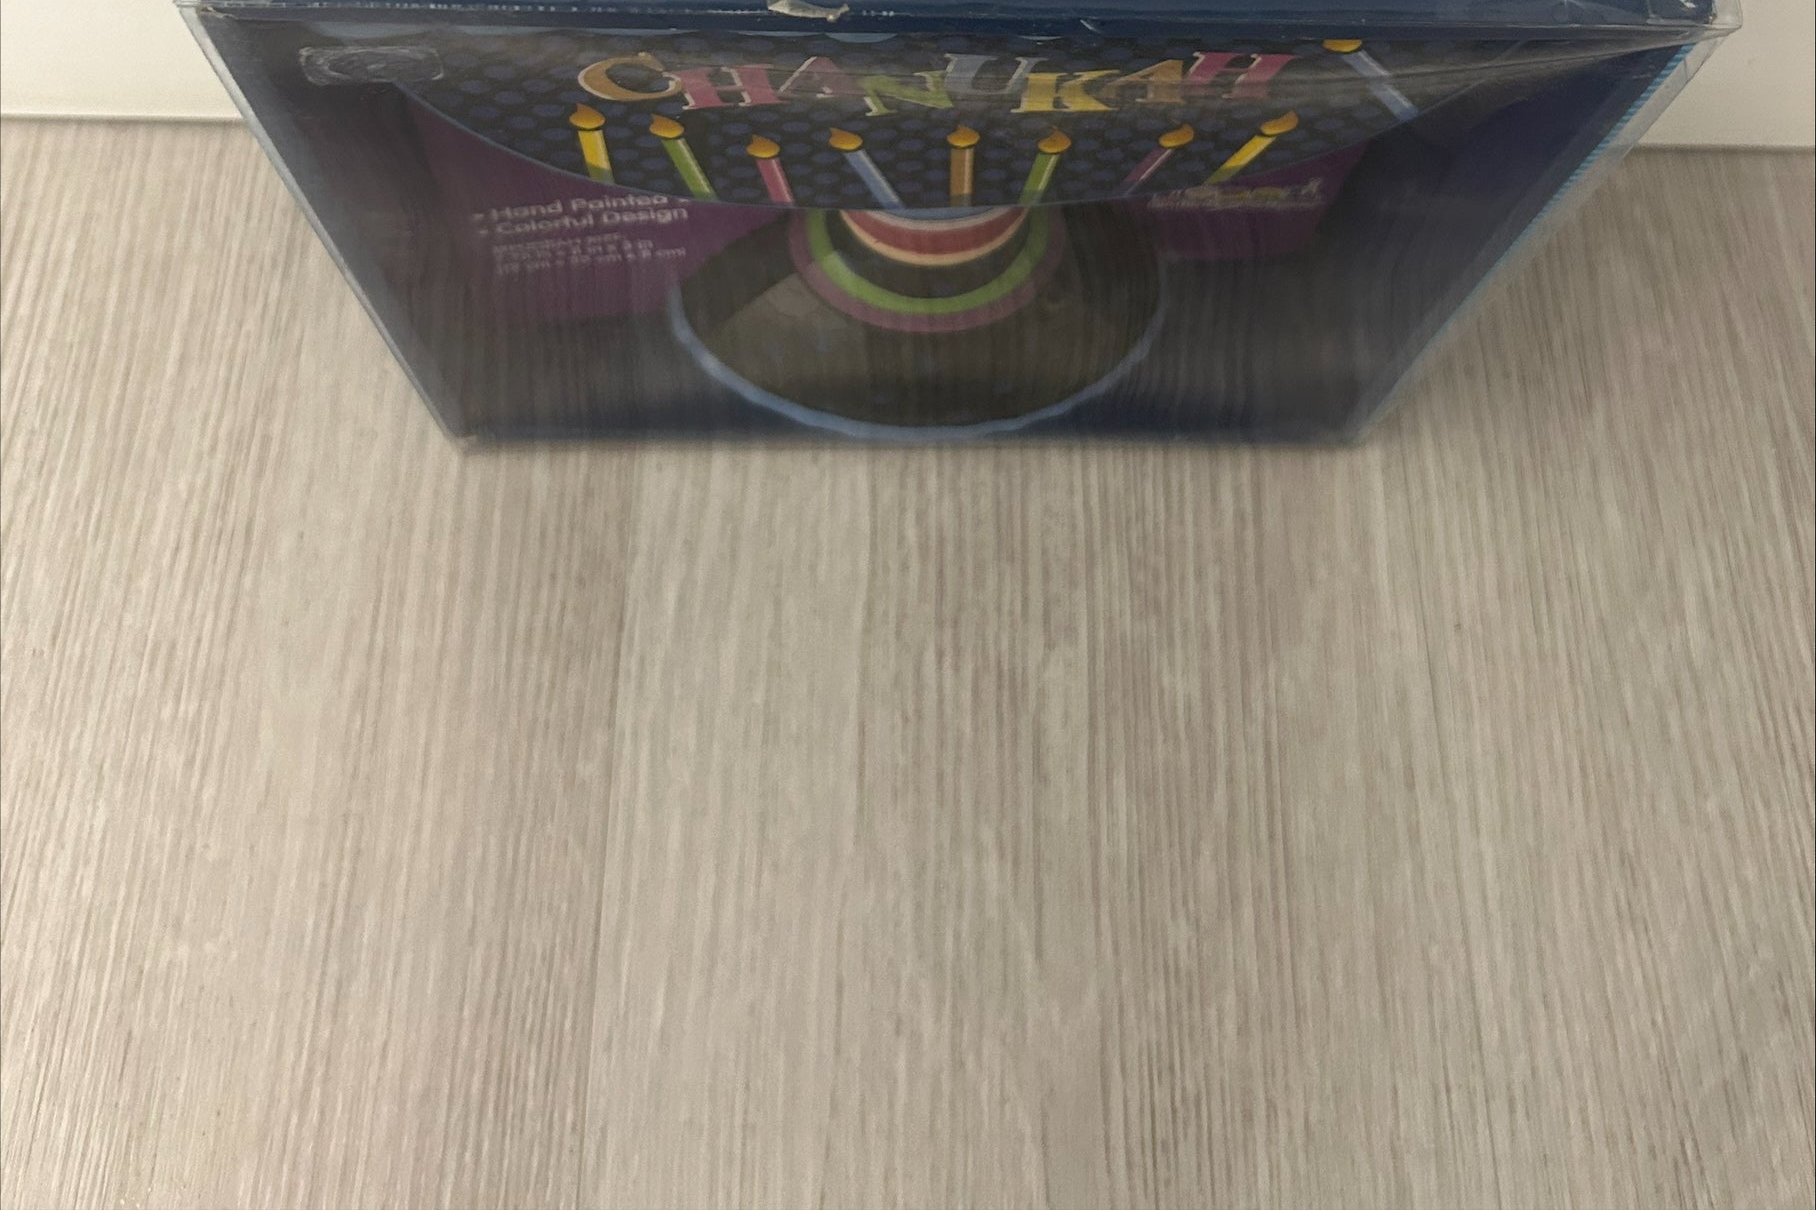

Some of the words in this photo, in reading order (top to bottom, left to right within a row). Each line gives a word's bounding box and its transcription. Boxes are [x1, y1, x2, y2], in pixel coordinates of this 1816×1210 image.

[577, 50, 1297, 117] CHANUKAH
[490, 199, 563, 221] Hand
[497, 213, 595, 234] Colorful
[602, 207, 689, 224] Design
